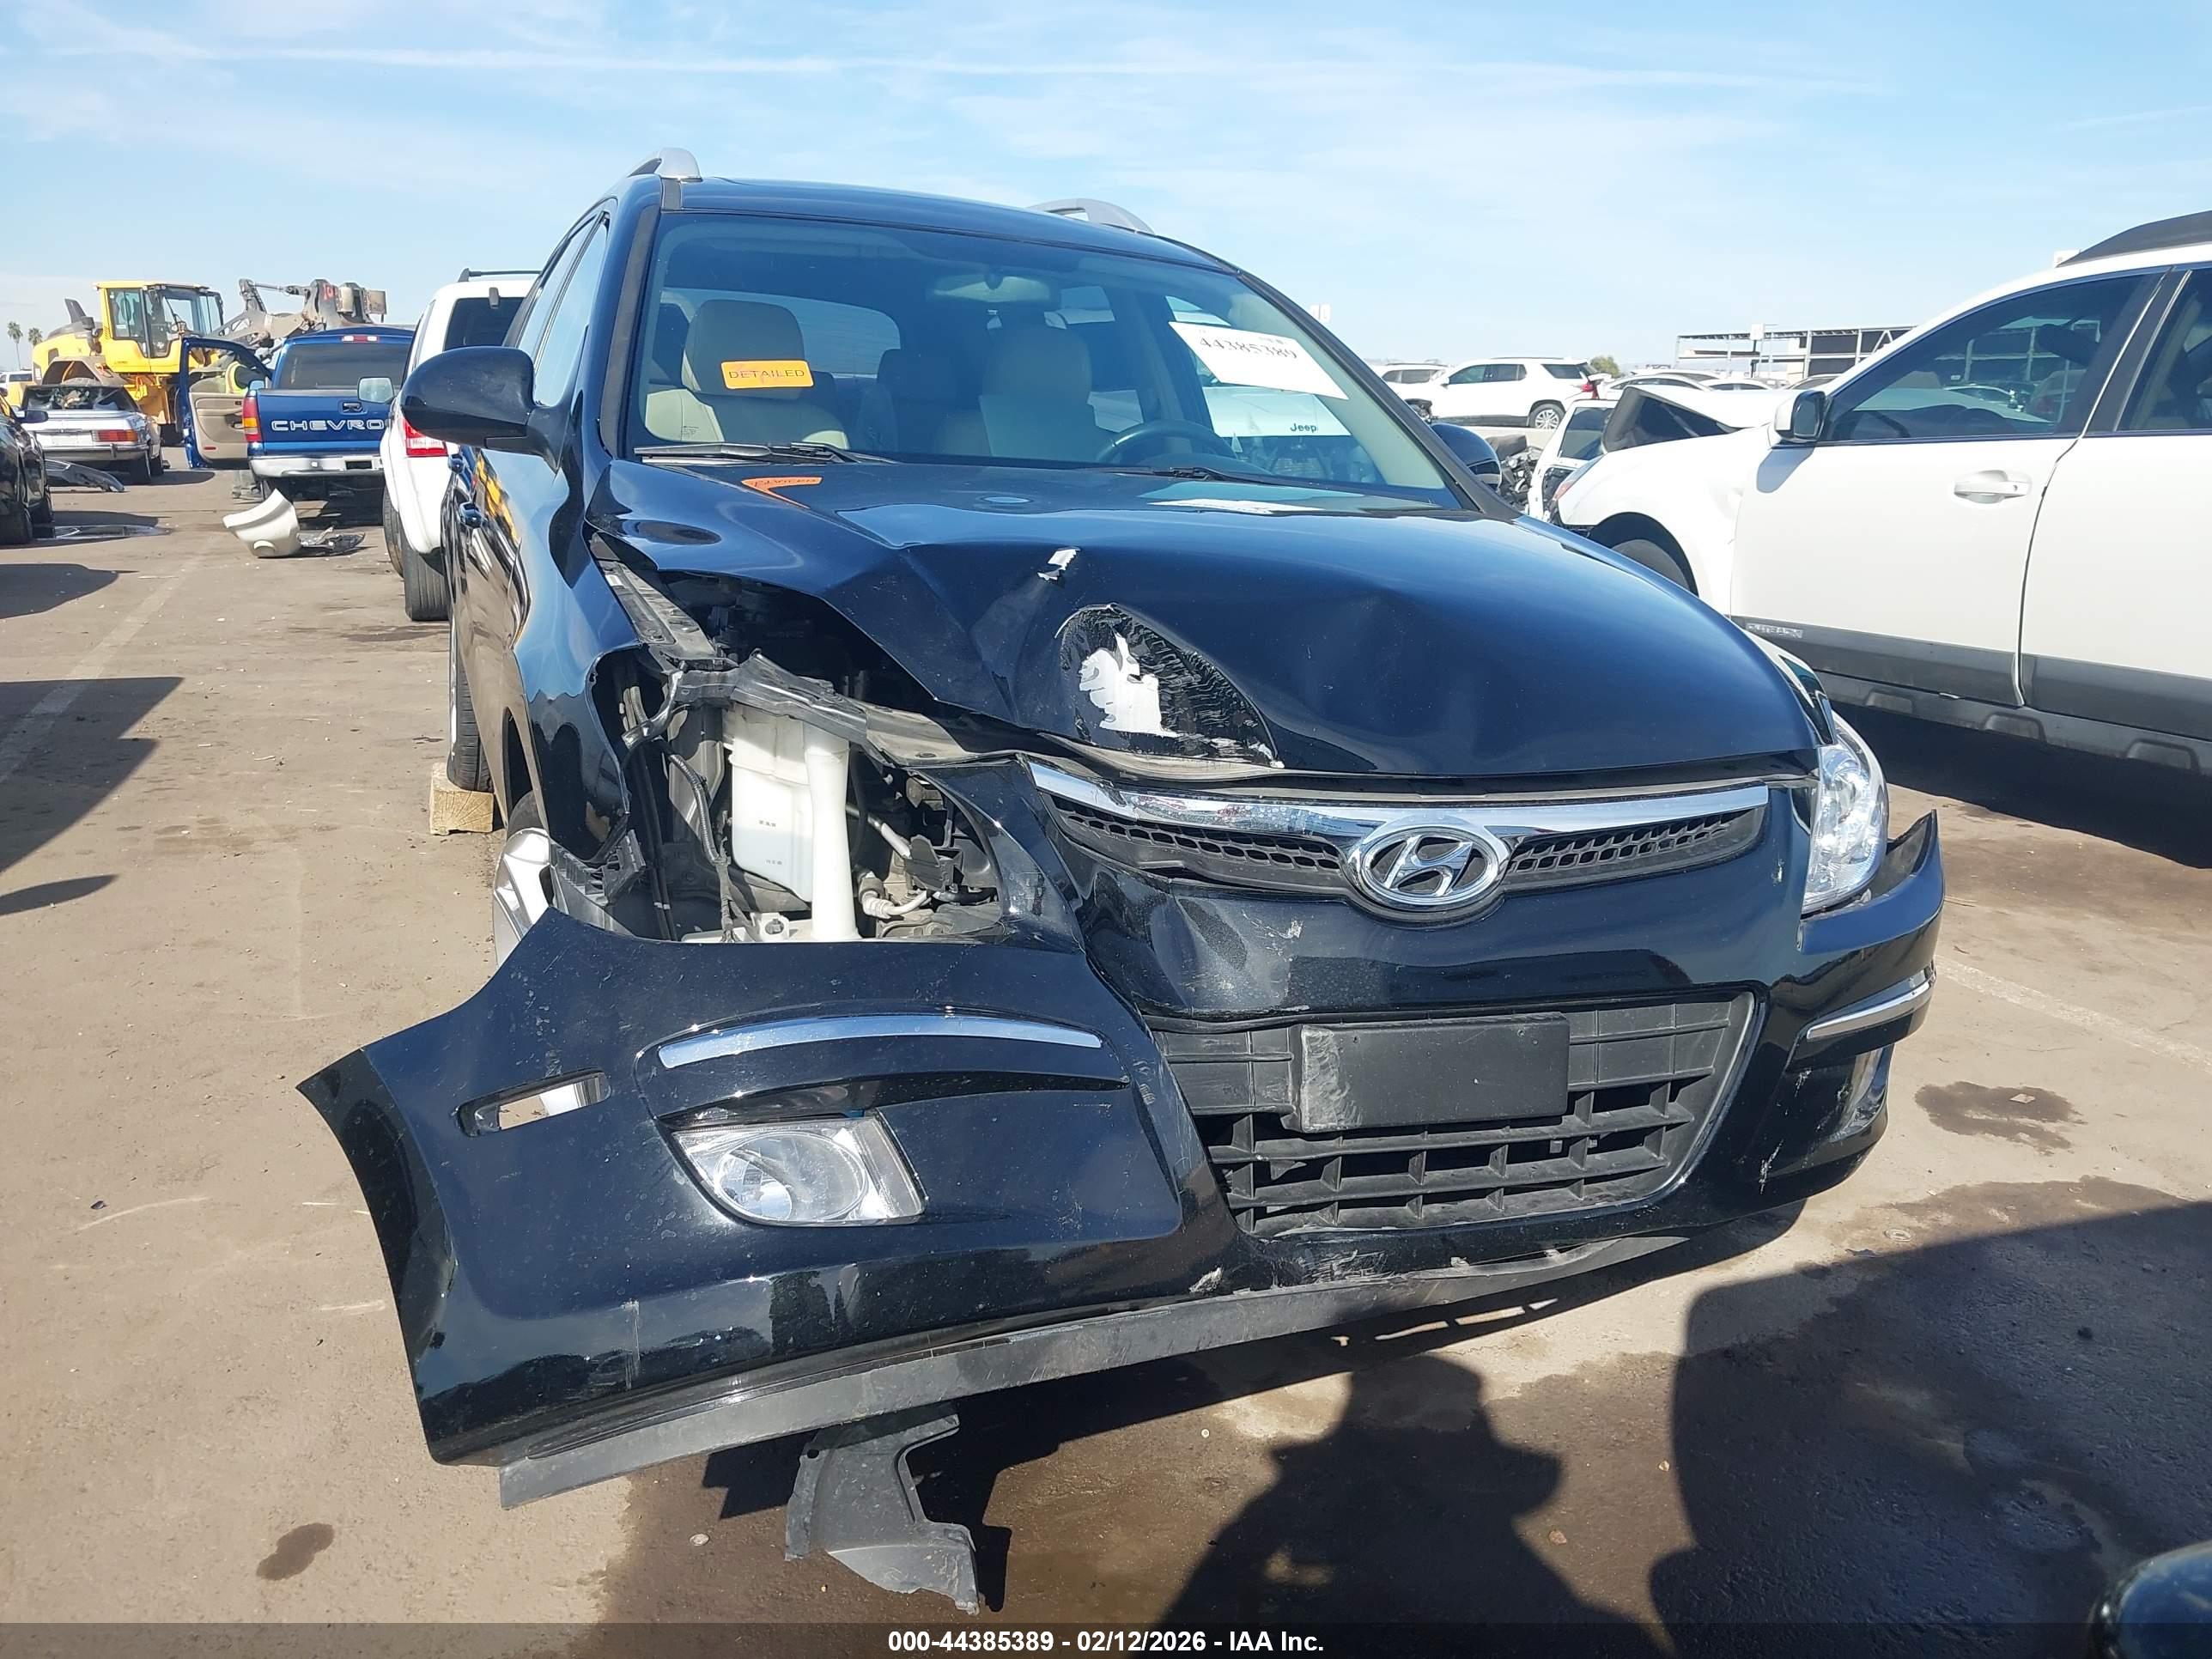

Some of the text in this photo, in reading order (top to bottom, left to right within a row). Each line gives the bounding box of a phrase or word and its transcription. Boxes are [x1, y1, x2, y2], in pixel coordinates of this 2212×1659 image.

[729, 369, 805, 379] DETAILED
[271, 419, 392, 431] CHEVRO
[1290, 422, 1317, 433] Jeep
